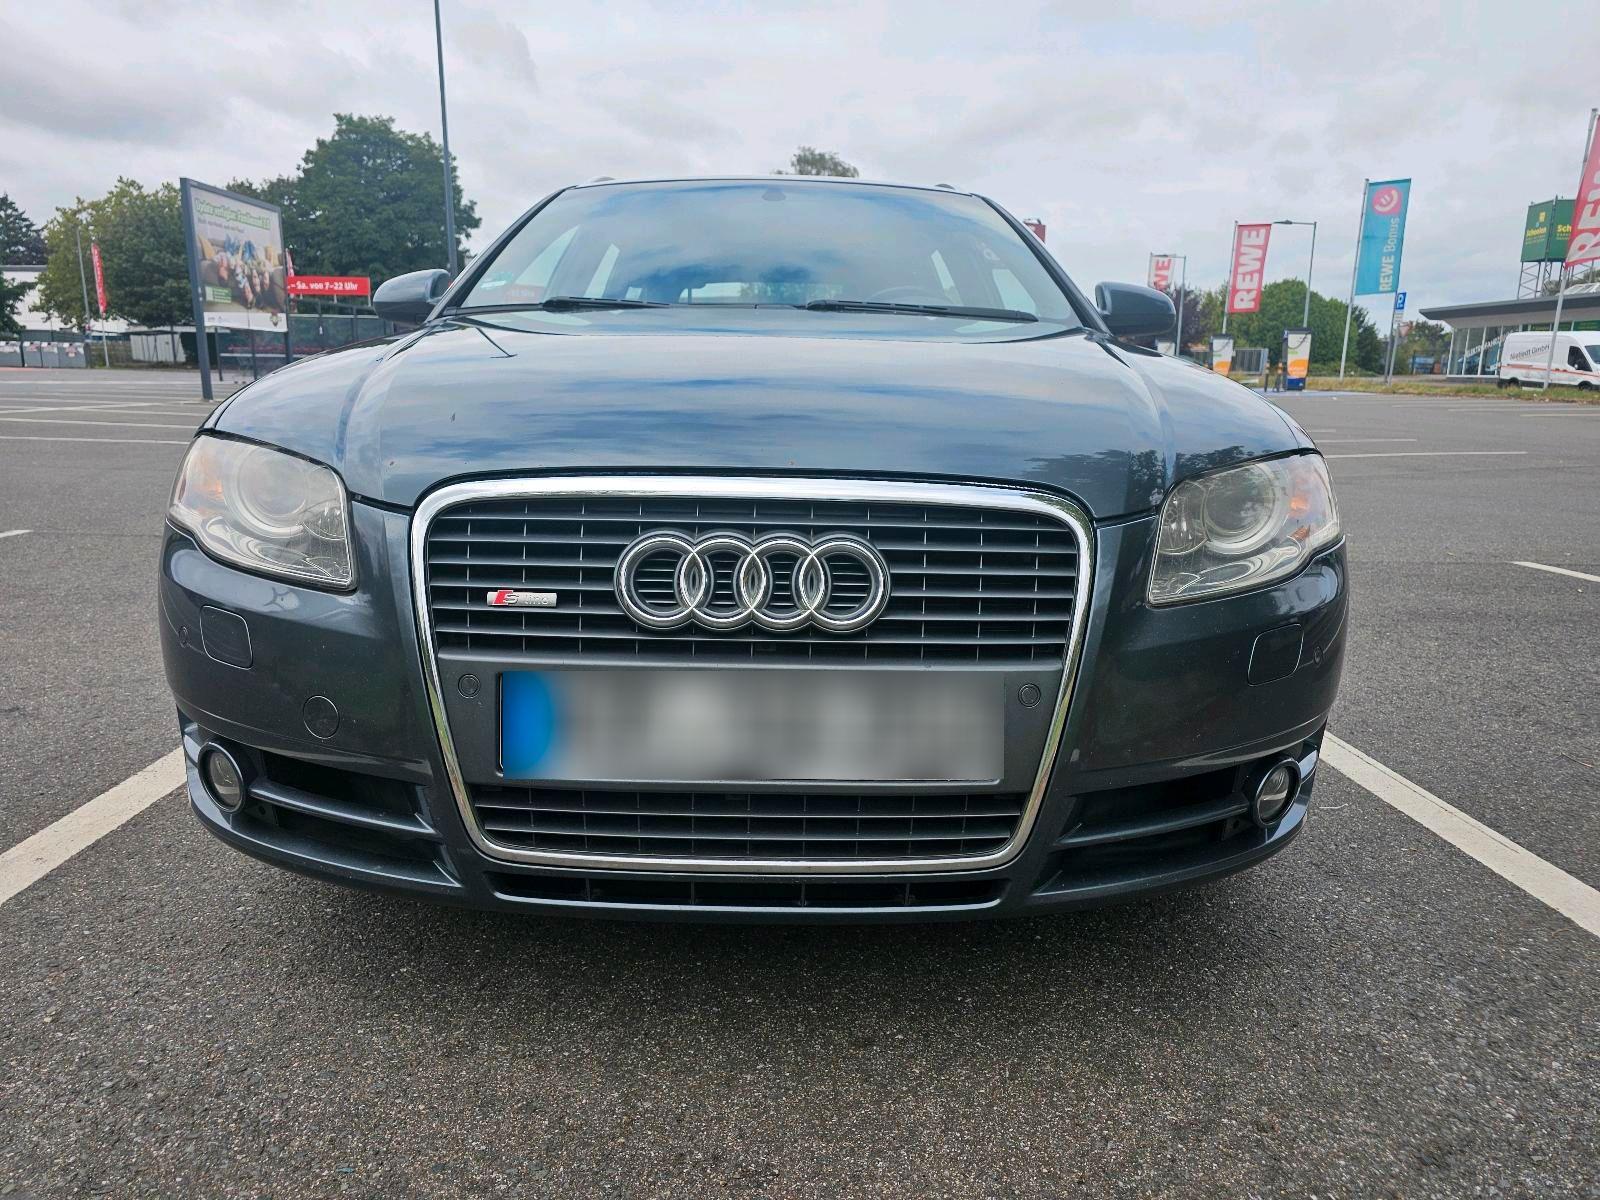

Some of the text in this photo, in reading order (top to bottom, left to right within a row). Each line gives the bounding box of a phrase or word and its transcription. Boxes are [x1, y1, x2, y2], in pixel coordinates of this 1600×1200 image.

[1153, 259, 1172, 290] WE
[1234, 228, 1266, 309] REWE
[1380, 217, 1400, 291] REWE Bonus
[344, 281, 358, 290] Uhr
